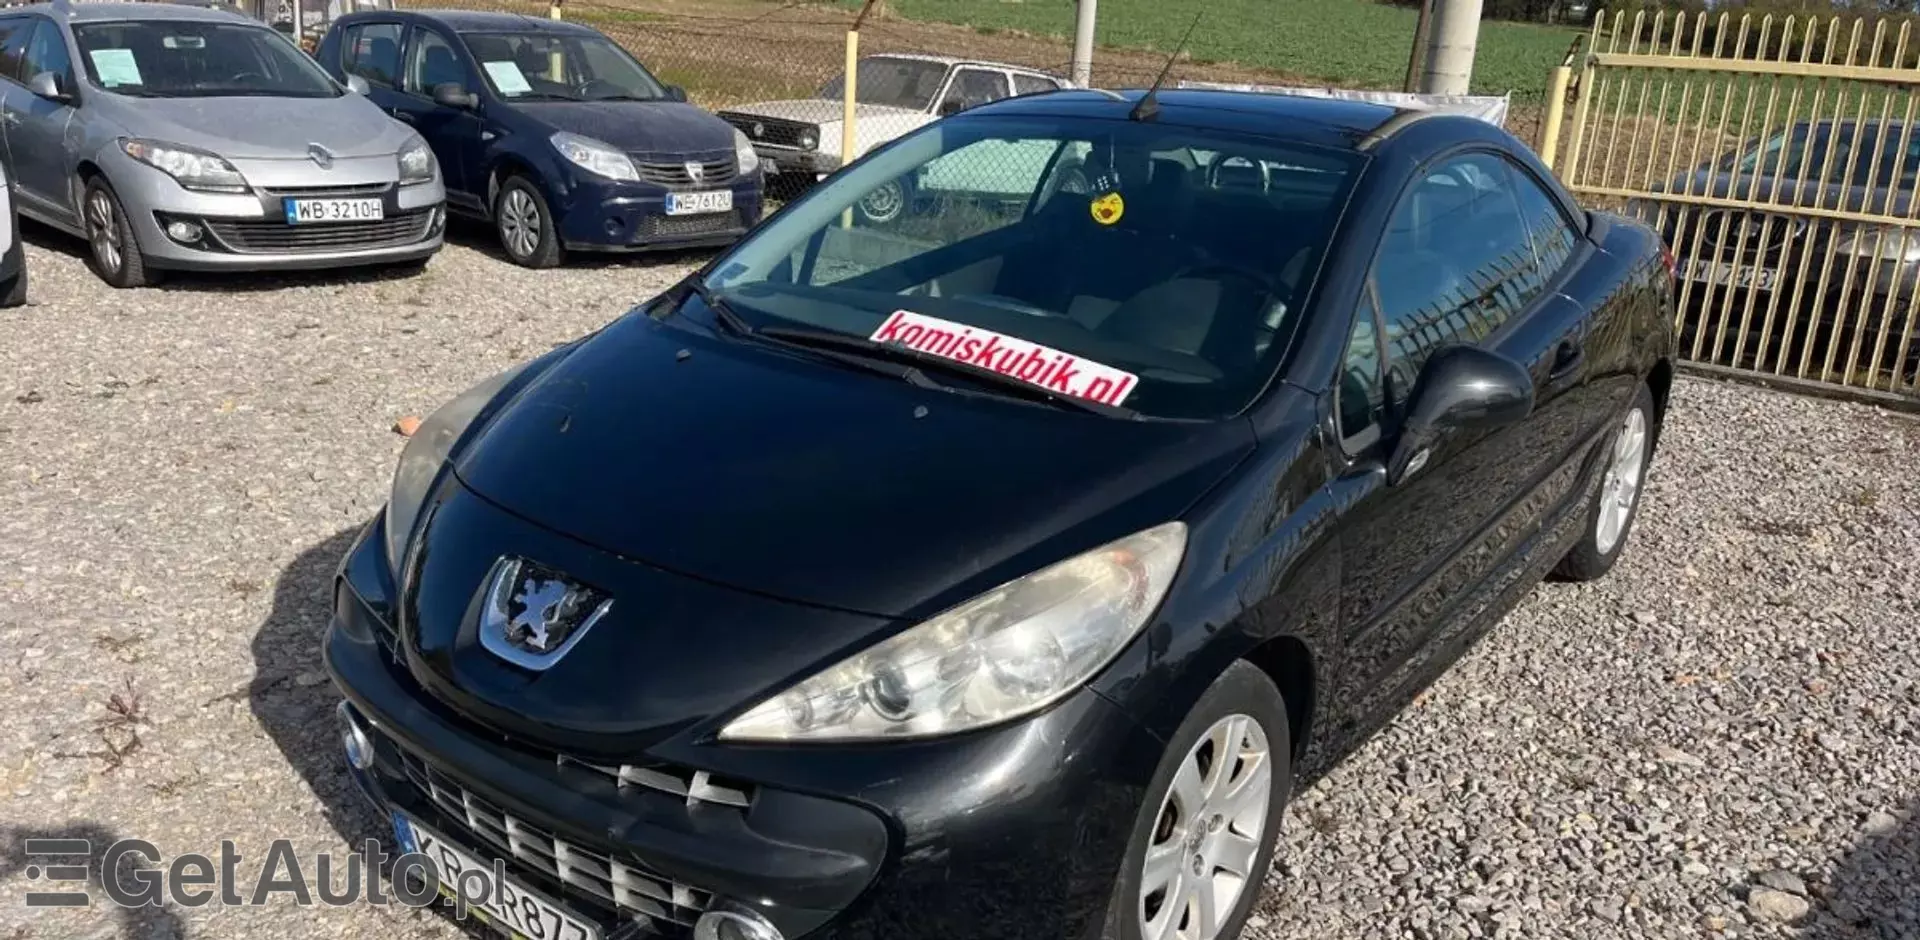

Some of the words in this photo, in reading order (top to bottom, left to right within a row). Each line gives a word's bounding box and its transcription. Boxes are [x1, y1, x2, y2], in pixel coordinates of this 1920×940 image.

[298, 202, 325, 219] WB
[331, 201, 381, 218] 3210H
[877, 312, 1131, 405] komiskubik.pl
